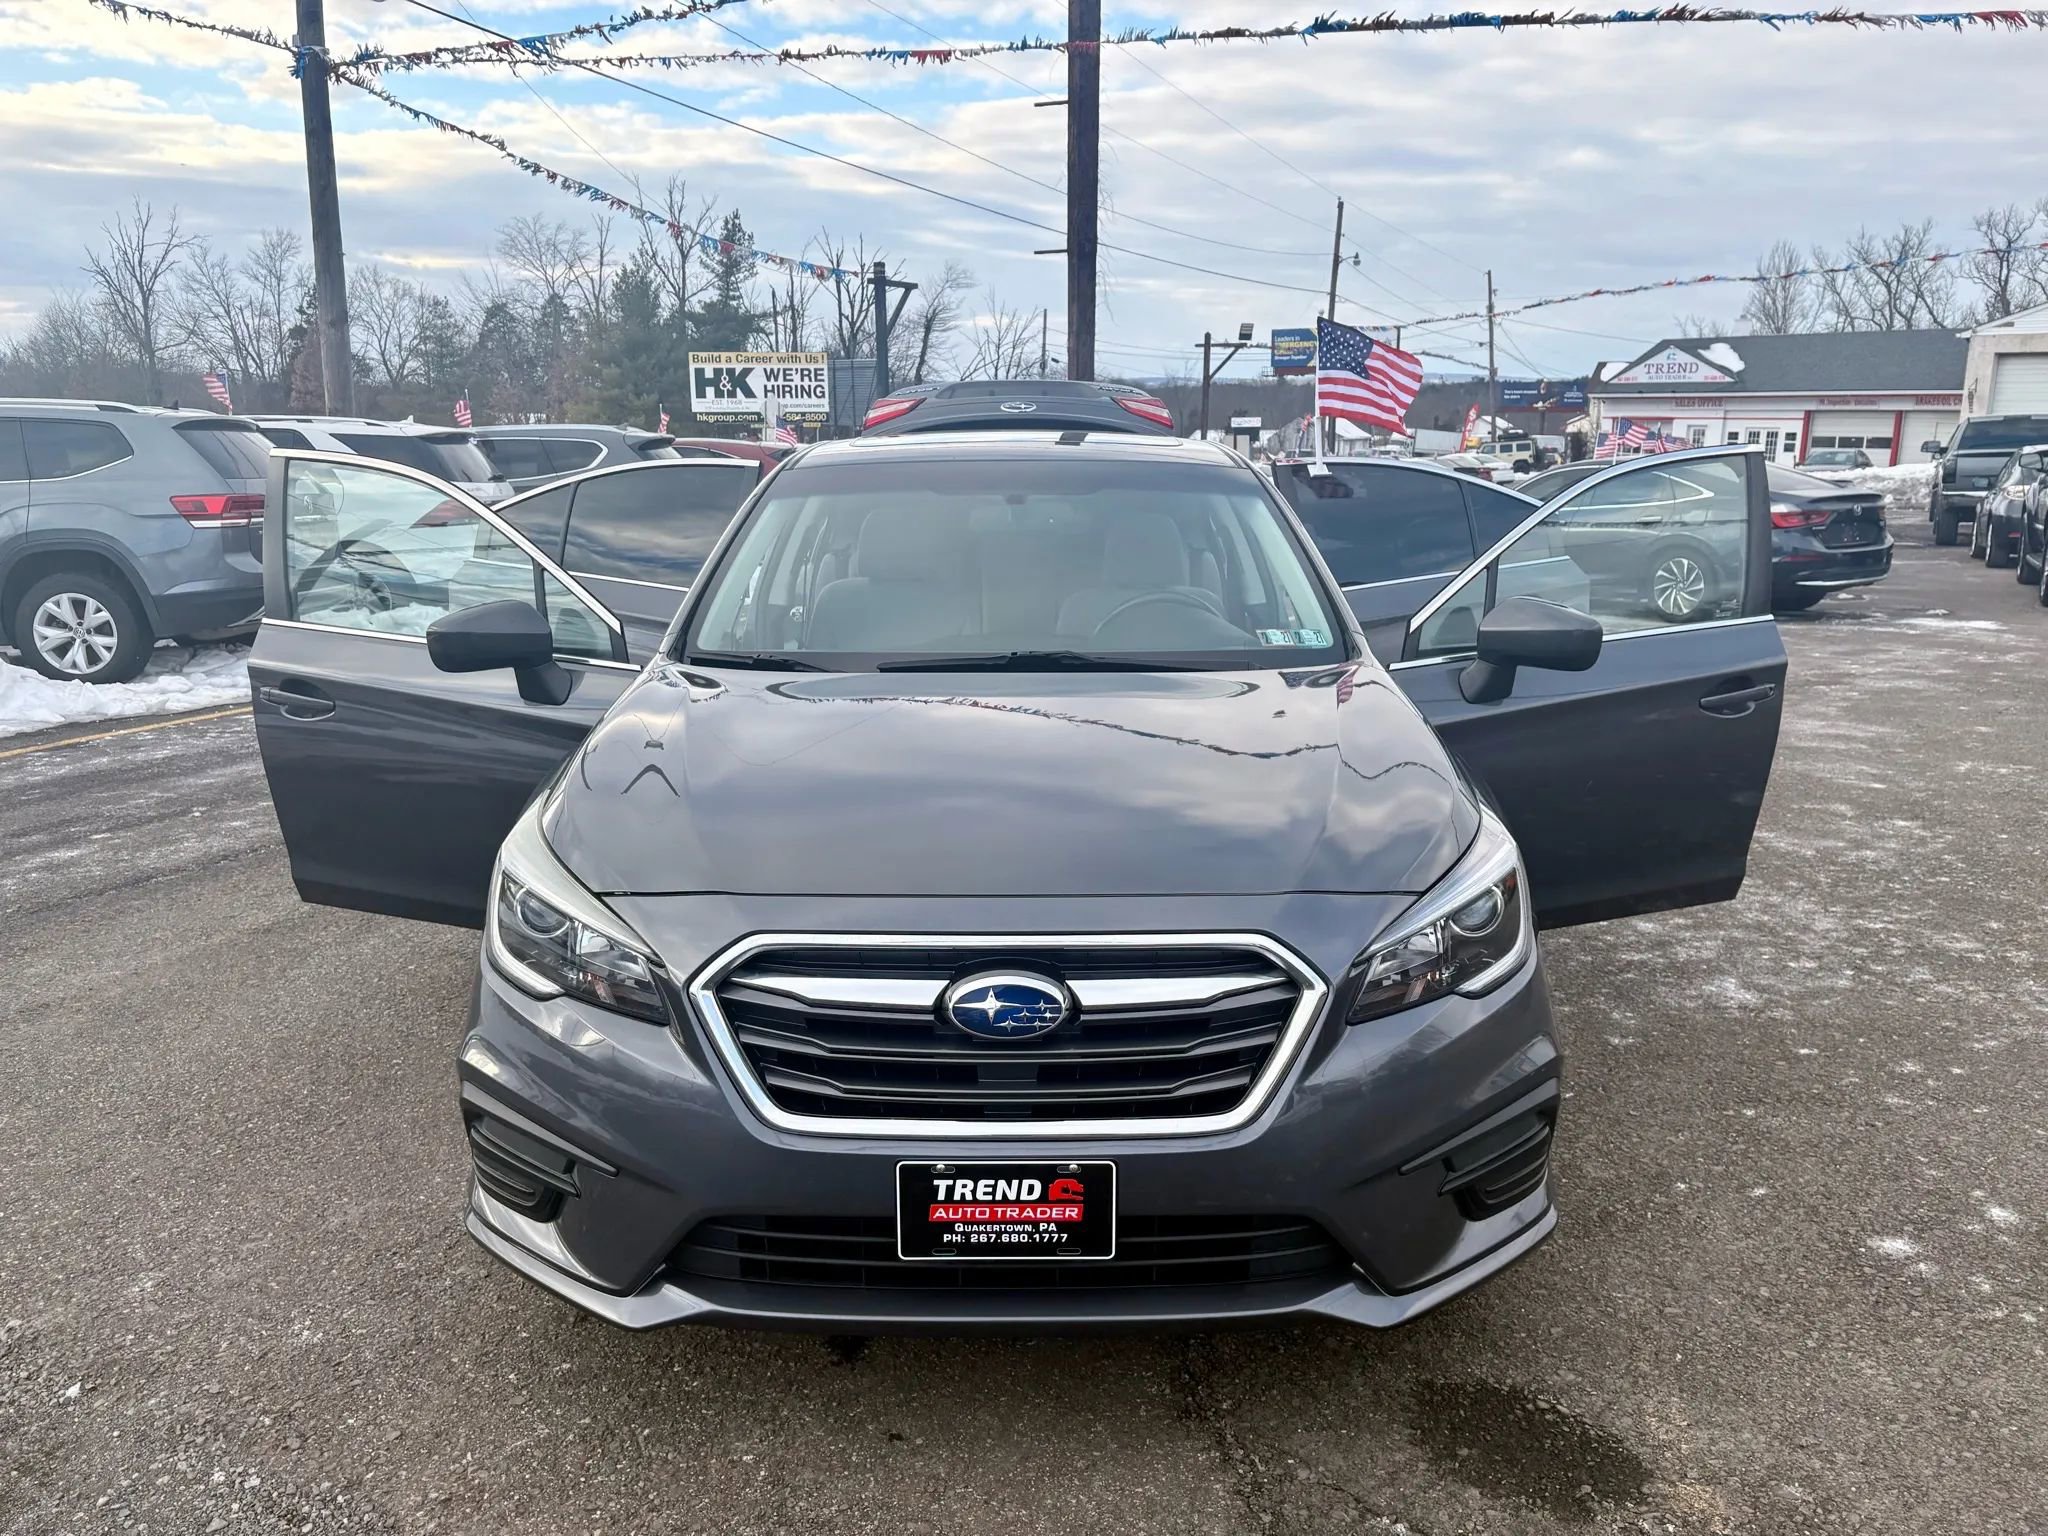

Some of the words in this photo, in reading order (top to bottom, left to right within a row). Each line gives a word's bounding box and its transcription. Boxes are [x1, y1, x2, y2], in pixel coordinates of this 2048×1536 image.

[692, 354, 721, 363] Build
[736, 354, 773, 363] Career
[776, 354, 801, 363] with
[1644, 362, 1699, 374] TREND
[763, 367, 825, 382] WE'RE
[694, 367, 757, 398] H&K
[763, 384, 826, 398] HIRING
[933, 1179, 1042, 1201] TREND
[932, 1207, 990, 1219] AUTO
[993, 1207, 1079, 1219] TRADER
[954, 1223, 1035, 1233] QUAKERTOWN,
[1039, 1223, 1057, 1232] PA
[943, 1233, 965, 1243] PH:
[970, 1233, 1068, 1243] 267.680.1777
